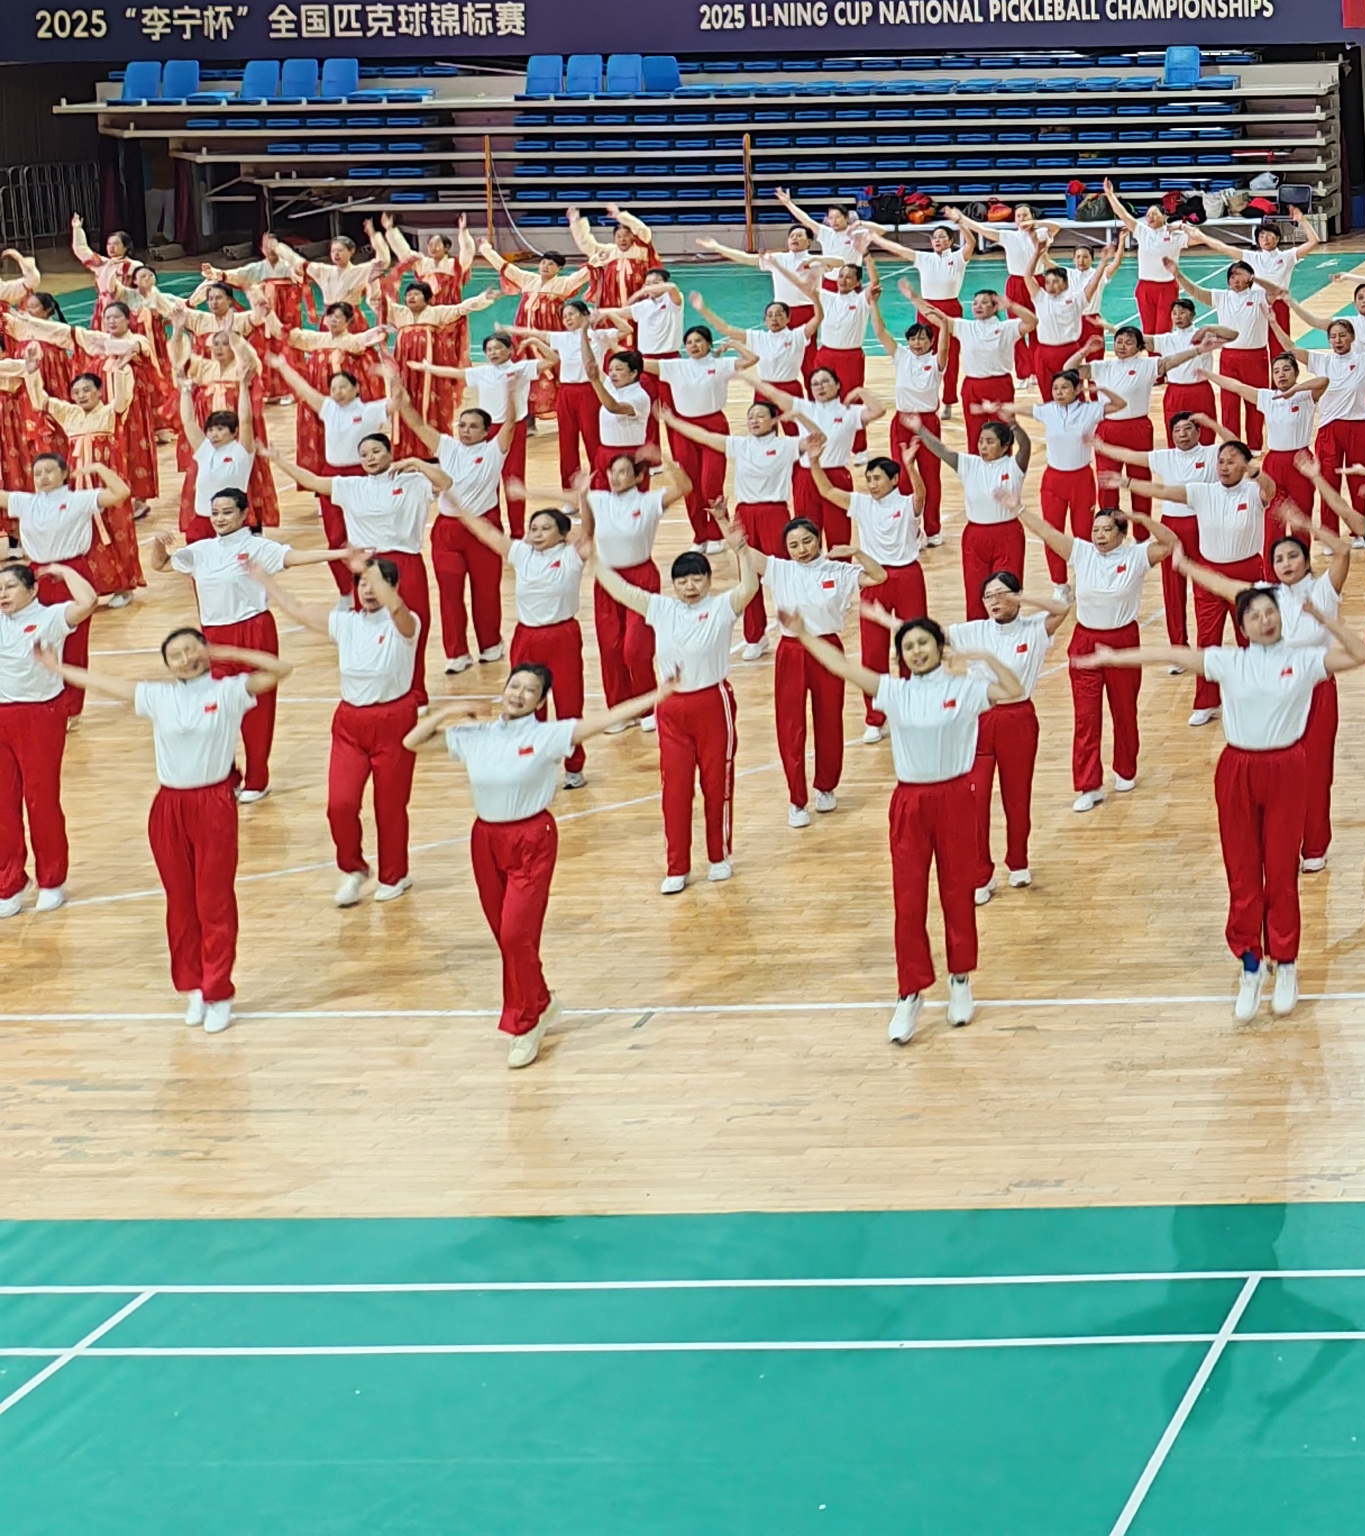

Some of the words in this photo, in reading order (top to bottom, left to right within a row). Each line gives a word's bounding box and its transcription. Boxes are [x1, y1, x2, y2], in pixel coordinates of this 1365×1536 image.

[699, 4, 746, 31] 2025
[751, 1, 829, 28] LI-NING
[833, 0, 875, 26] CUP
